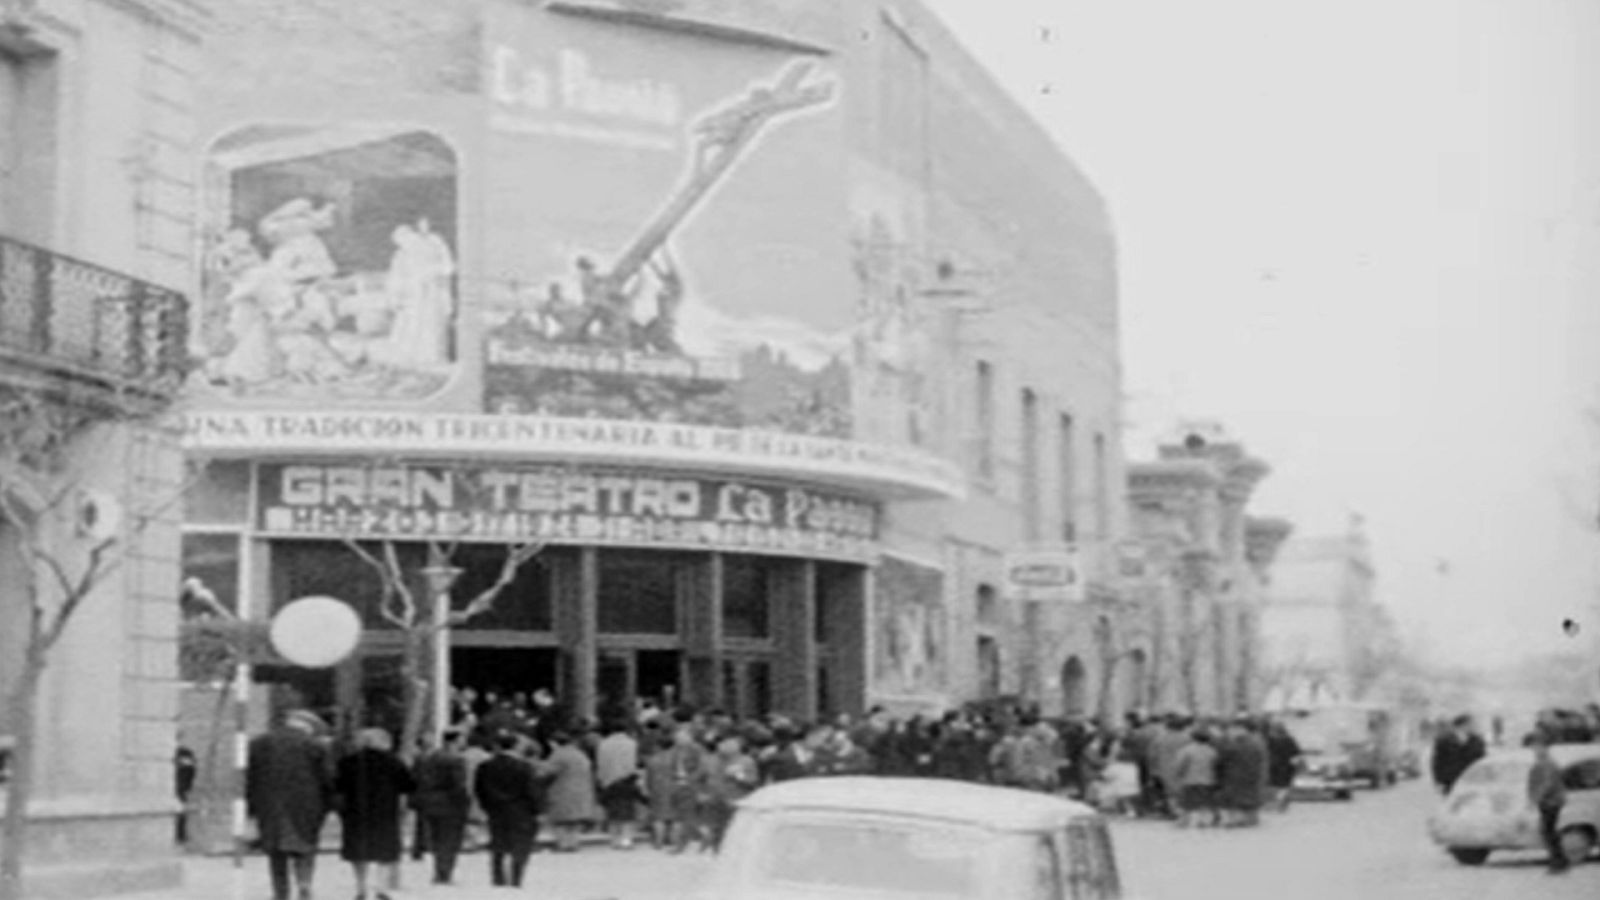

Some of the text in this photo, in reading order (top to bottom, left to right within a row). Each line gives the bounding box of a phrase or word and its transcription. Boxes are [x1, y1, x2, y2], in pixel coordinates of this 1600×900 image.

[281, 466, 453, 508] GRAN
[481, 471, 699, 518] TEATRO
[716, 482, 771, 523] La
